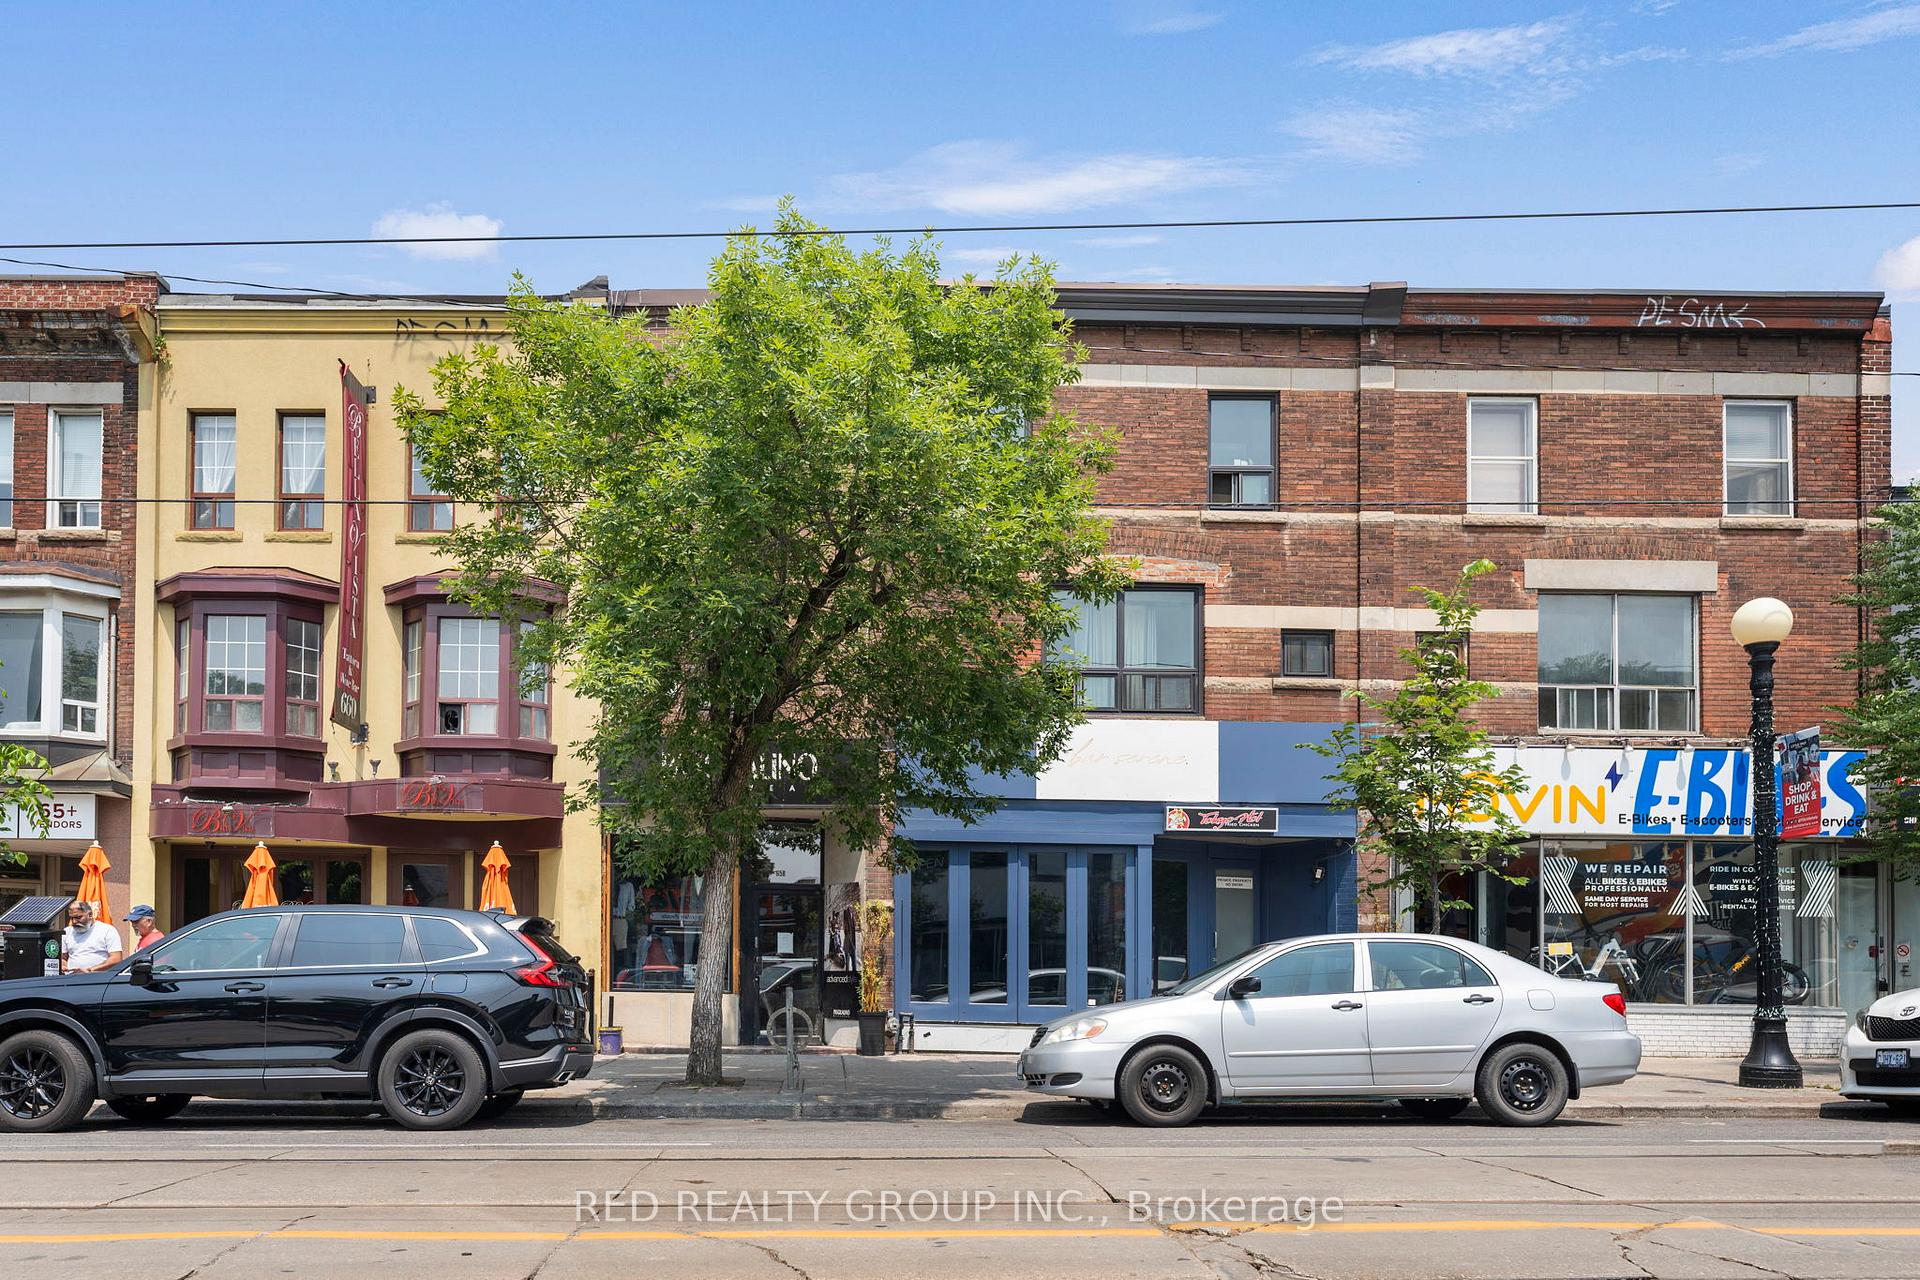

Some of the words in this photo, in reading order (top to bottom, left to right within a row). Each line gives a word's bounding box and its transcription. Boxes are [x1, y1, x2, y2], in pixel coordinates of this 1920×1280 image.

[340, 692, 357, 719] 660
[1785, 792, 1810, 806] DRINK
[1811, 790, 1817, 801] &
[1793, 803, 1809, 815] EAT
[1618, 814, 1667, 825] E-Bikes
[1680, 815, 1751, 827] E-scooters
[1585, 863, 1607, 874] WE
[1614, 864, 1667, 875] REPAIR
[1585, 877, 1600, 885] ALL
[1602, 877, 1628, 886] BIKES
[1628, 877, 1635, 886] &
[1636, 878, 1668, 886] EBIKES
[1585, 885, 1669, 893] PROFESSIONALLY.
